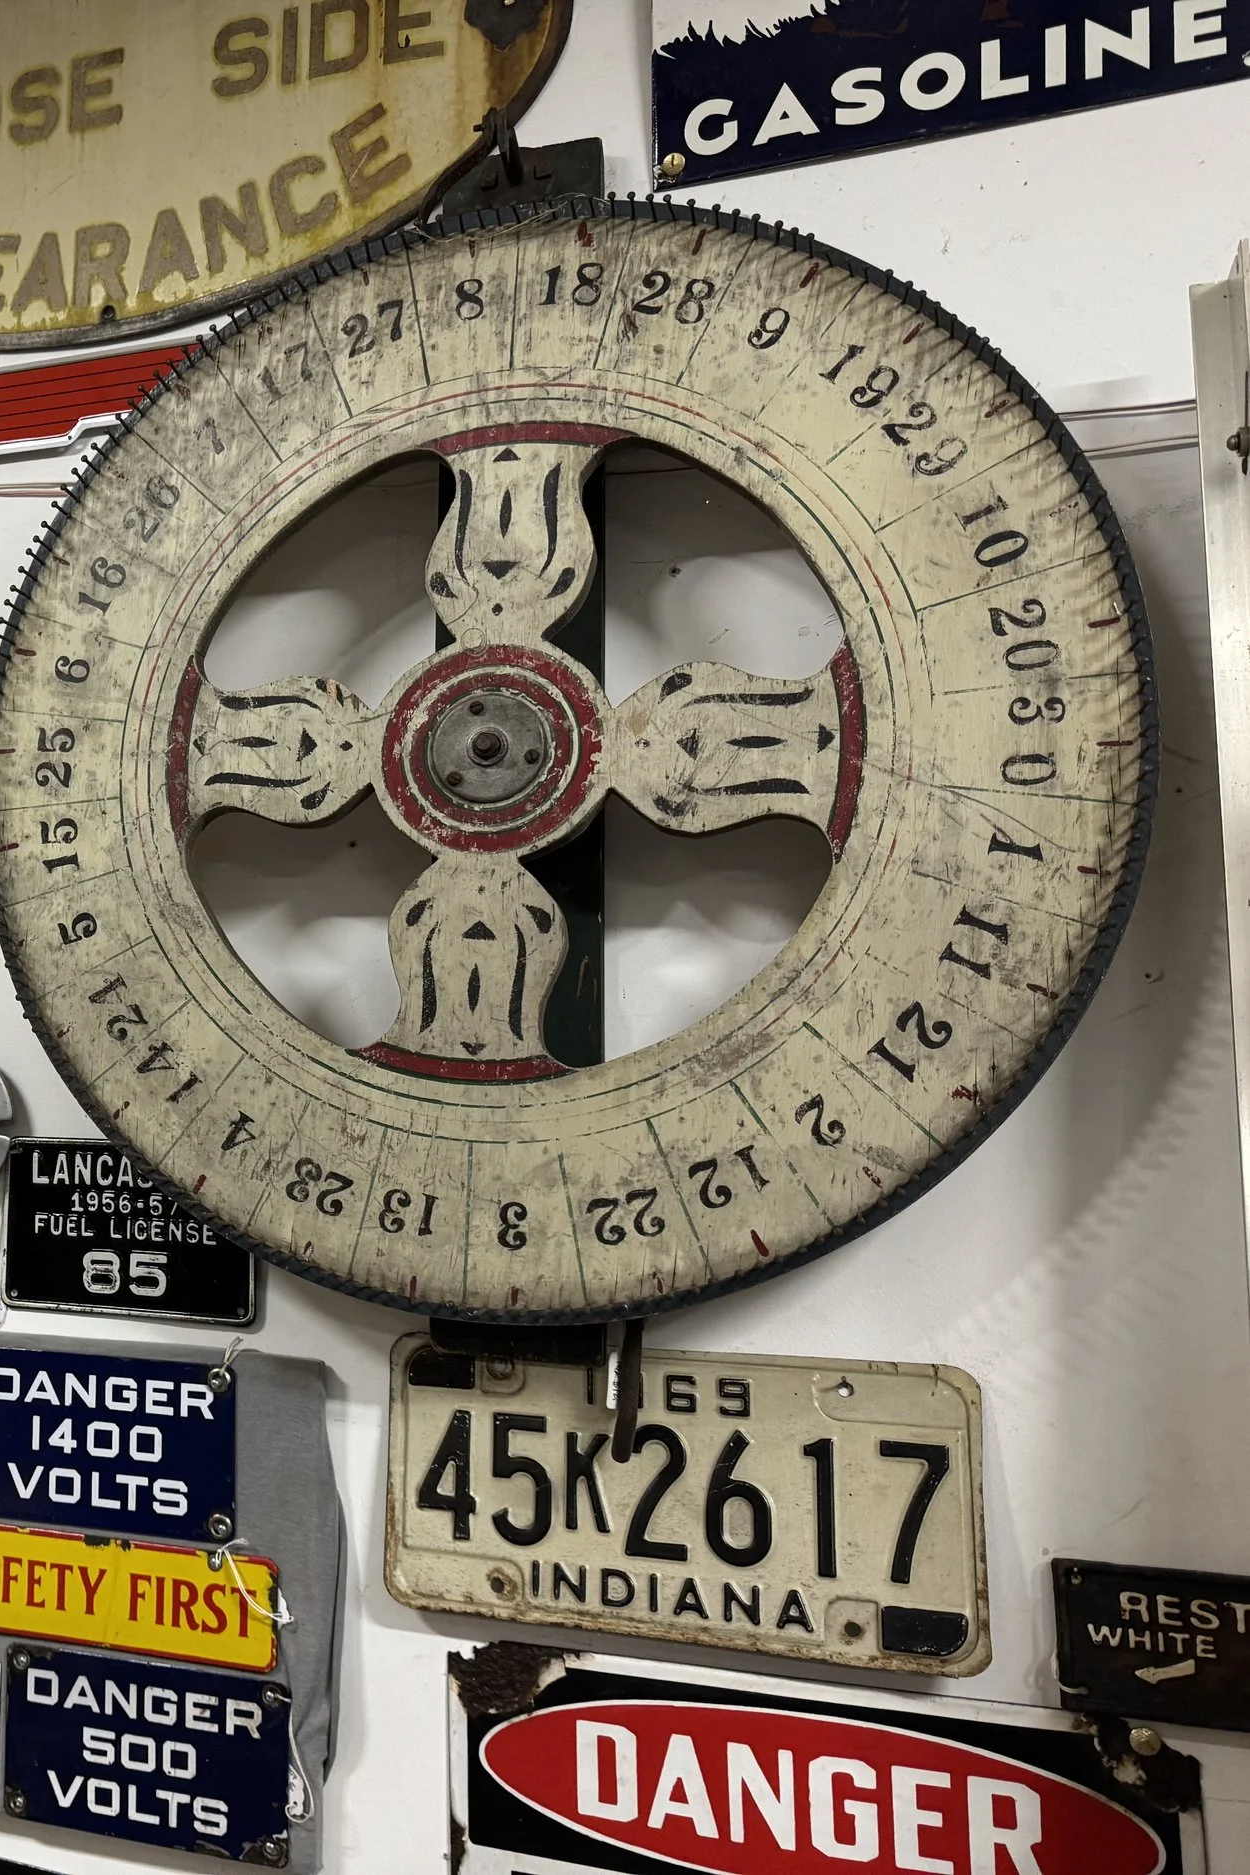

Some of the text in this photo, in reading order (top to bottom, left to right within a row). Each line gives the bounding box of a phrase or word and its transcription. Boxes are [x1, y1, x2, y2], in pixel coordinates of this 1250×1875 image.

[211, 0, 444, 98] SIDE
[455, 278, 485, 321] 8
[539, 262, 605, 306] 18
[633, 270, 715, 324] 28
[340, 299, 405, 359] 27
[747, 307, 791, 350] 9
[257, 340, 314, 405] 17
[818, 344, 900, 409] 19
[881, 401, 968, 476] 29
[955, 494, 1029, 568] 10
[77, 556, 127, 616] 16
[988, 597, 1061, 671] 20
[54, 655, 91, 684] 6
[35, 727, 75, 789] 25
[999, 696, 1067, 786] 30
[42, 816, 80, 874] 15
[988, 831, 1043, 863] 1
[57, 911, 98, 945] 5
[938, 905, 1010, 980] 11
[867, 1000, 953, 1084] 21
[135, 1042, 204, 1105] 14
[220, 1109, 256, 1152] 4
[794, 1092, 846, 1147] 2
[285, 1156, 354, 1217] 23
[688, 1144, 771, 1209] 12
[34, 1211, 217, 1246] FUEL LICENSE
[377, 1188, 440, 1237] 13
[497, 1201, 529, 1251] 3
[586, 1187, 665, 1246] 22
[82, 1249, 168, 1297] 85
[31, 1415, 163, 1463] 1400
[7, 1462, 188, 1516] VOLTS
[417, 1410, 950, 1584] 45K2617
[128, 1572, 257, 1638] FIRST
[531, 1560, 814, 1634] INDIANA
[1087, 1623, 1218, 1659] WHITE
[27, 1668, 262, 1740] DANGER
[82, 1726, 197, 1780] 500
[47, 1770, 229, 1837] VOLTS
[575, 1719, 1044, 1875] DANGER
